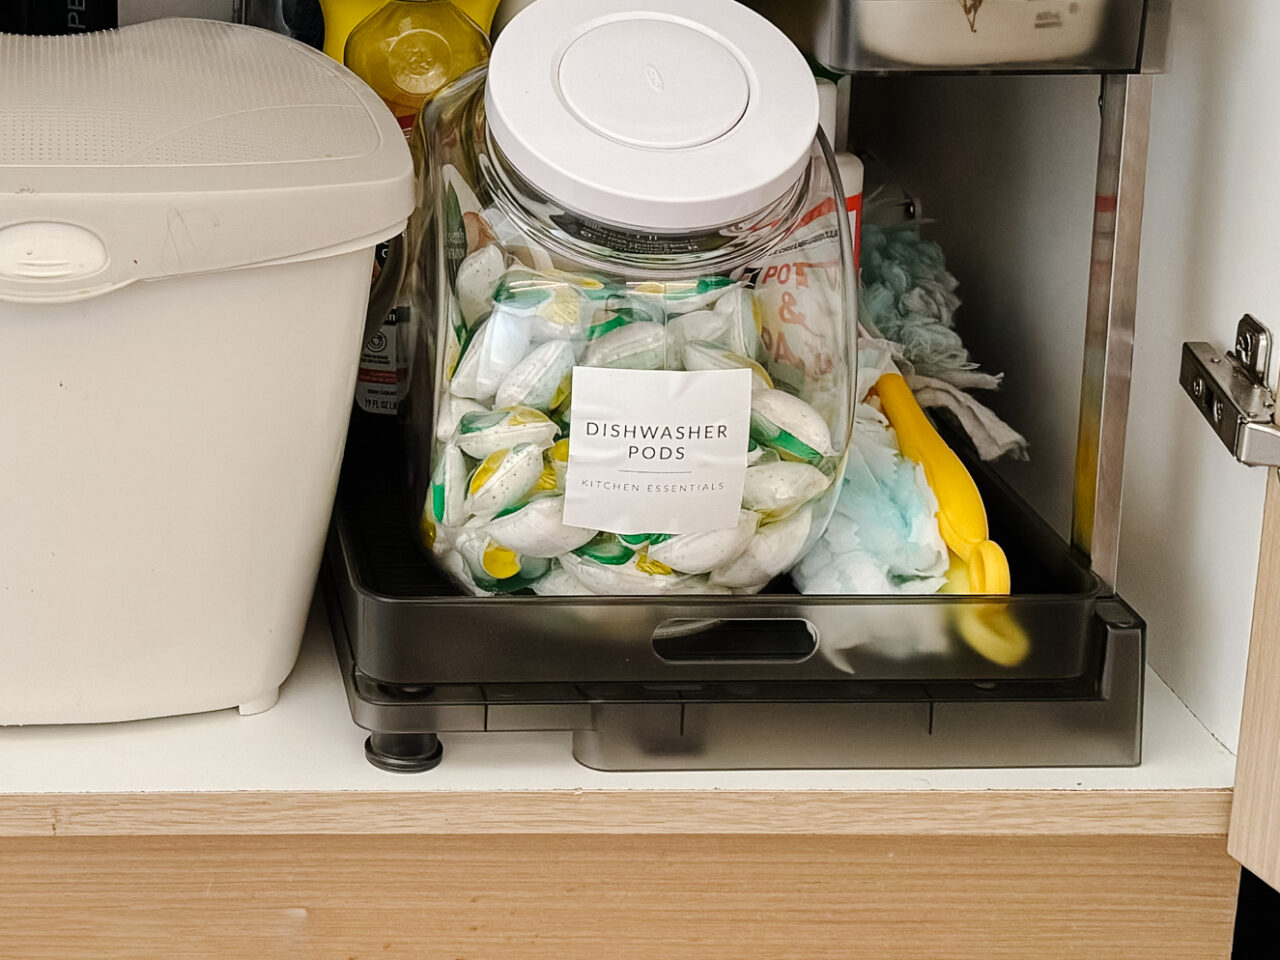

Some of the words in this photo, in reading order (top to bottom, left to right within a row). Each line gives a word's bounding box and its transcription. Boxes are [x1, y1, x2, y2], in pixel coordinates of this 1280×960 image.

[586, 422, 728, 440] DISHWASHER
[628, 446, 686, 460] PODS
[581, 480, 639, 492] KITCHEN
[647, 482, 725, 493] ESSENTIALS
